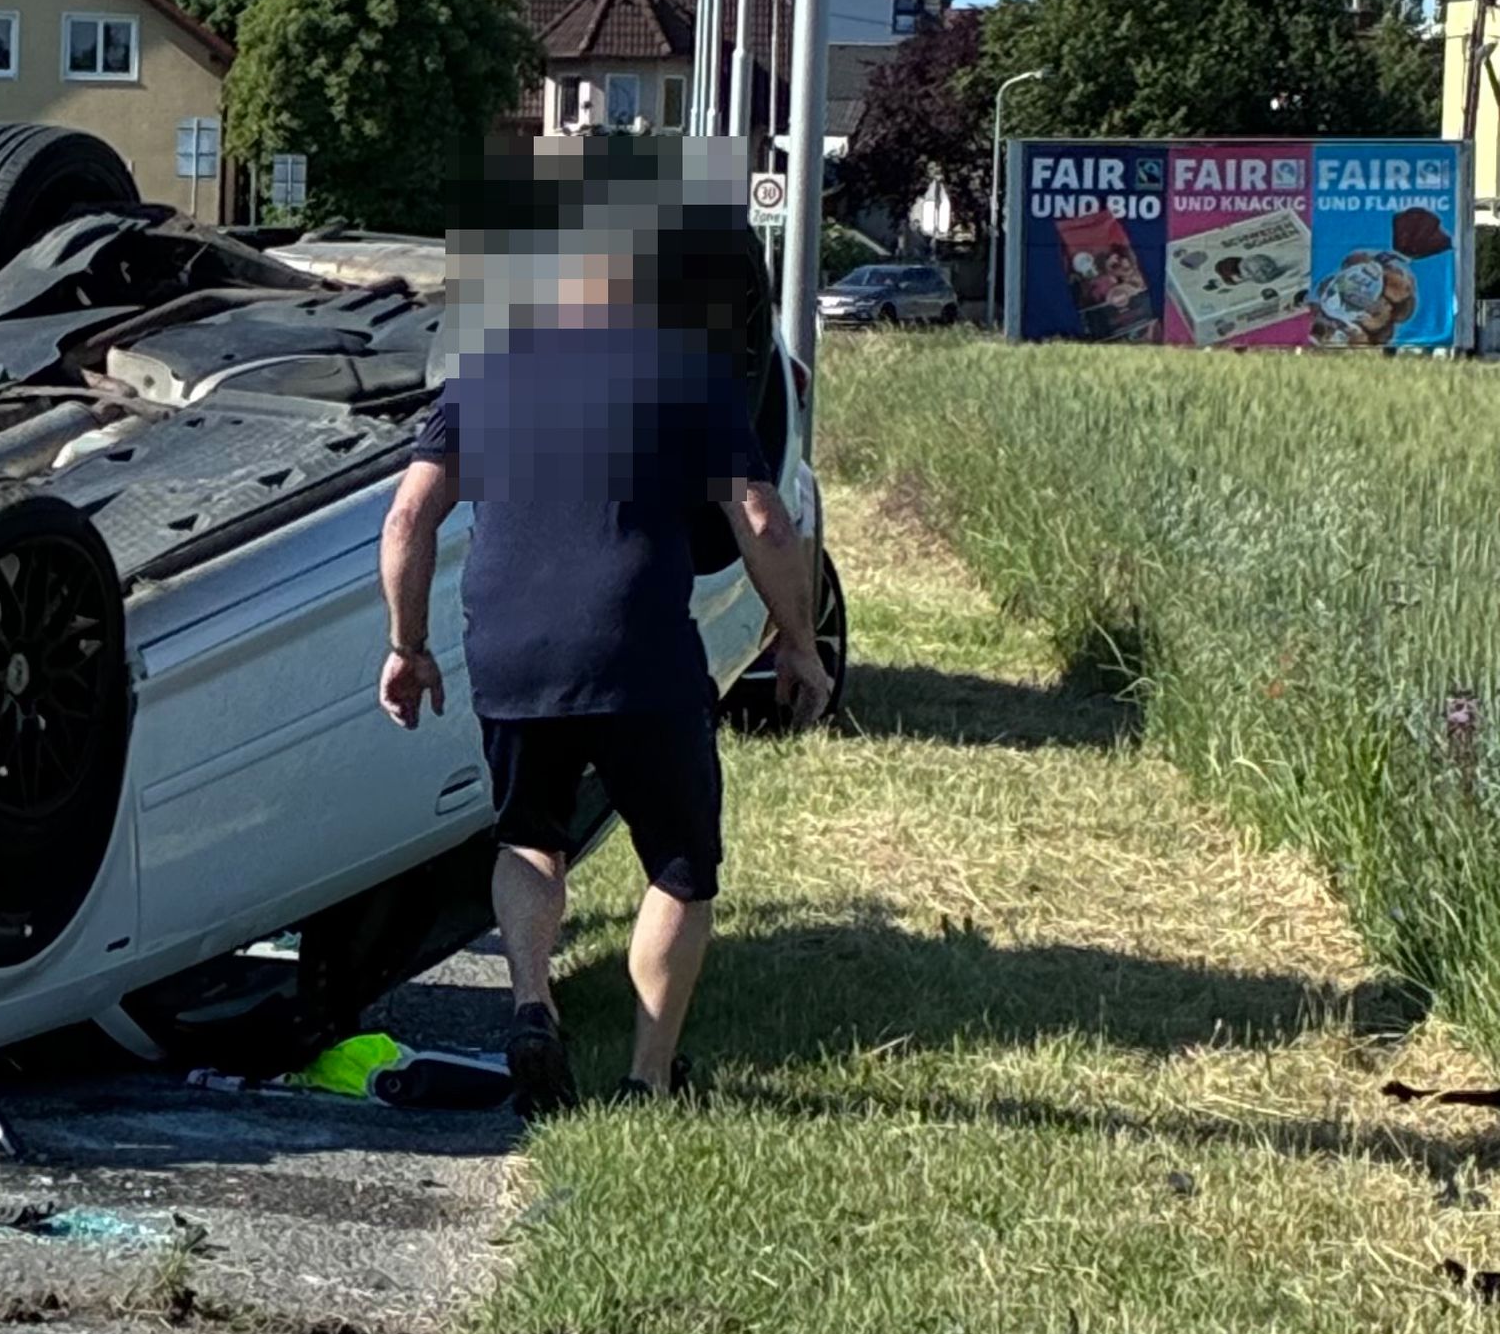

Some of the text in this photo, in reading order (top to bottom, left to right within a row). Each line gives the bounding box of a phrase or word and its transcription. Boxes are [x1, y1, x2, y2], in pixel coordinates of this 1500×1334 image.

[1031, 158, 1125, 190] FAIR
[1174, 159, 1268, 191] FAIR
[1318, 159, 1412, 190] FAIR
[761, 186, 777, 200] 30
[1031, 194, 1161, 220] UND BIO
[1174, 196, 1306, 212] UND KNACKIG
[1318, 196, 1450, 212] UND FLAUMIG
[753, 209, 781, 224] Zone
